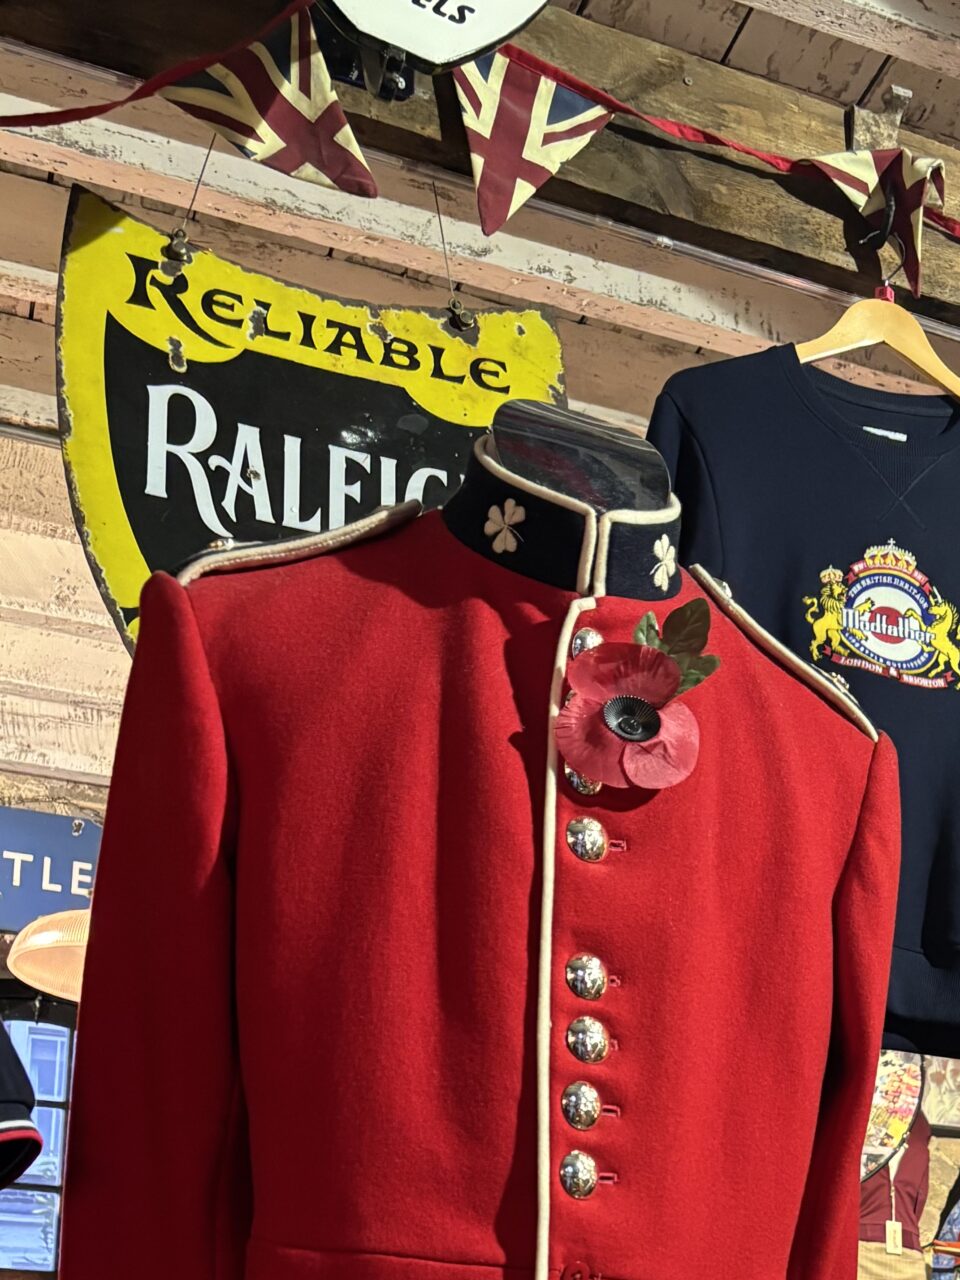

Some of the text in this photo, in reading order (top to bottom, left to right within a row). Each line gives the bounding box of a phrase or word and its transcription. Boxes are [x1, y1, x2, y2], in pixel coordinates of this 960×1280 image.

[125, 252, 511, 394] RELIABLE
[145, 384, 465, 537] RALEI
[840, 656, 883, 674] LONDON
[842, 608, 936, 645] Modfather
